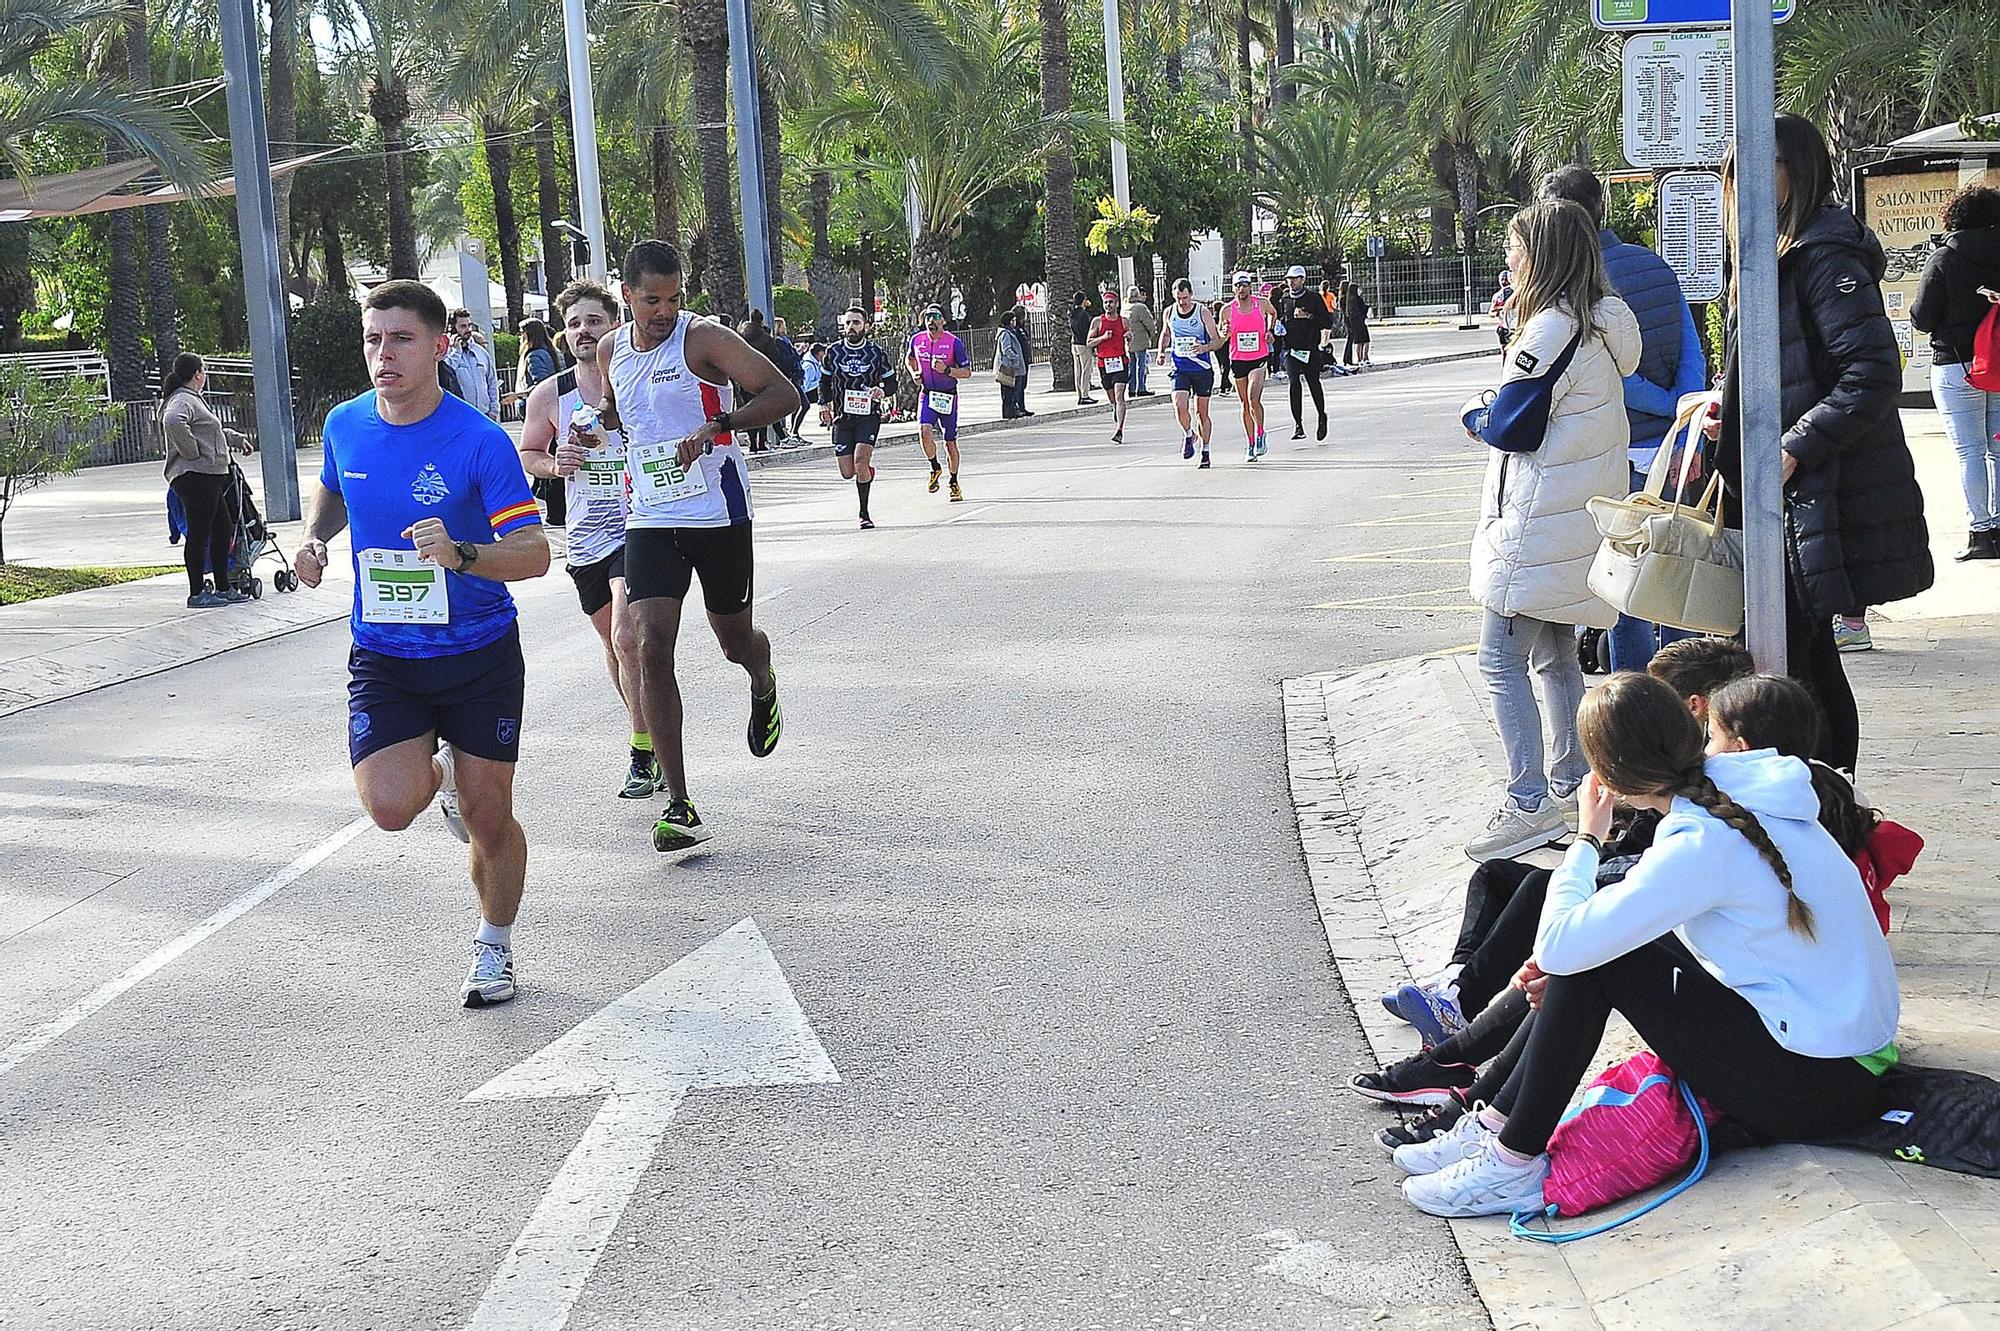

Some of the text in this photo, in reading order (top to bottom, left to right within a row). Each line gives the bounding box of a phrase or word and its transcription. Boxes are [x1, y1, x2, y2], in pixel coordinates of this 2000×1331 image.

[1614, 1, 1634, 9] TAXI
[1875, 189, 1916, 207] SALÓN
[1876, 215, 1935, 236] ANTIGUO
[1896, 331, 1911, 341] TIC
[1899, 341, 1911, 350] TO
[588, 472, 619, 486] 331
[653, 469, 685, 489] 219
[378, 583, 430, 603] 397
